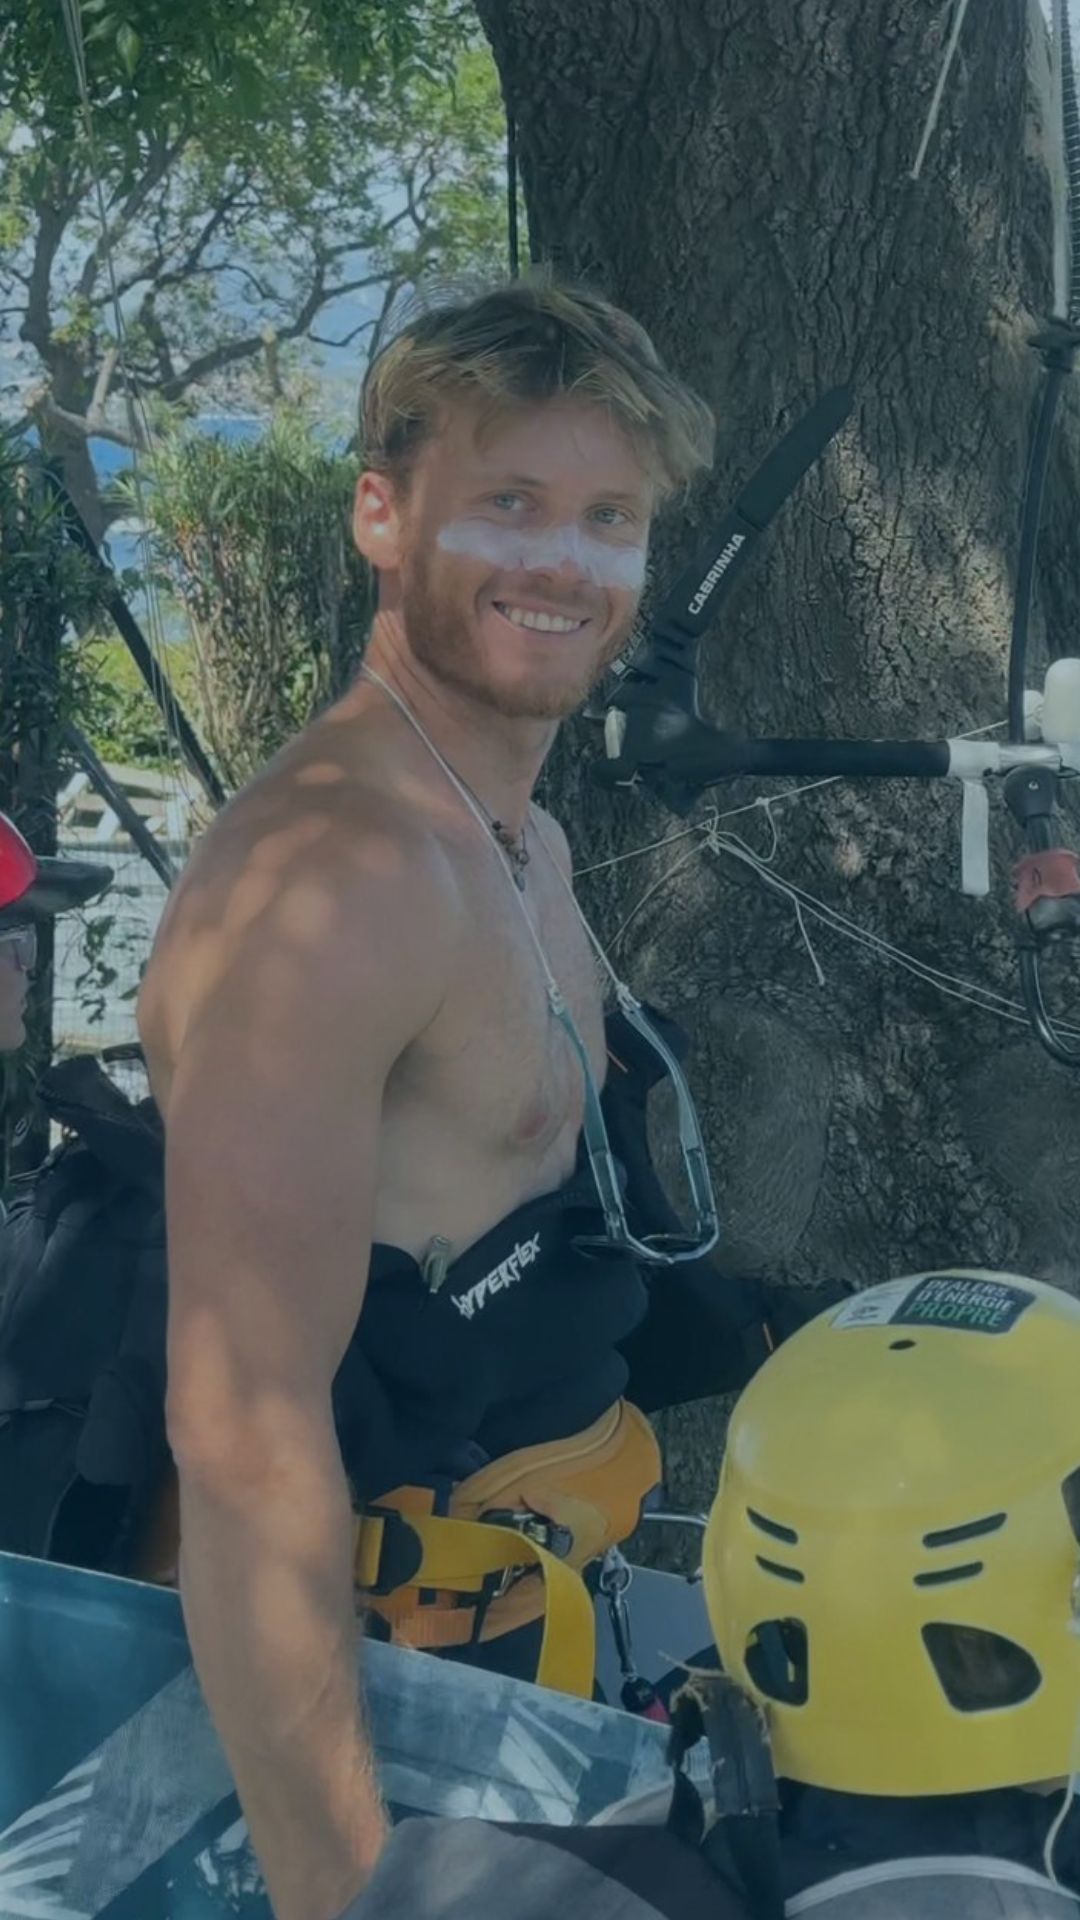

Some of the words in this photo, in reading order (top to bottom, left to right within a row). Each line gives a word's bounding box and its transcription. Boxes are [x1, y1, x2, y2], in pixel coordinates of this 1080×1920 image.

[688, 534, 746, 615] CABRINHA
[924, 1280, 1009, 1298] DEALERS
[903, 1302, 1007, 1327] PROPRE
